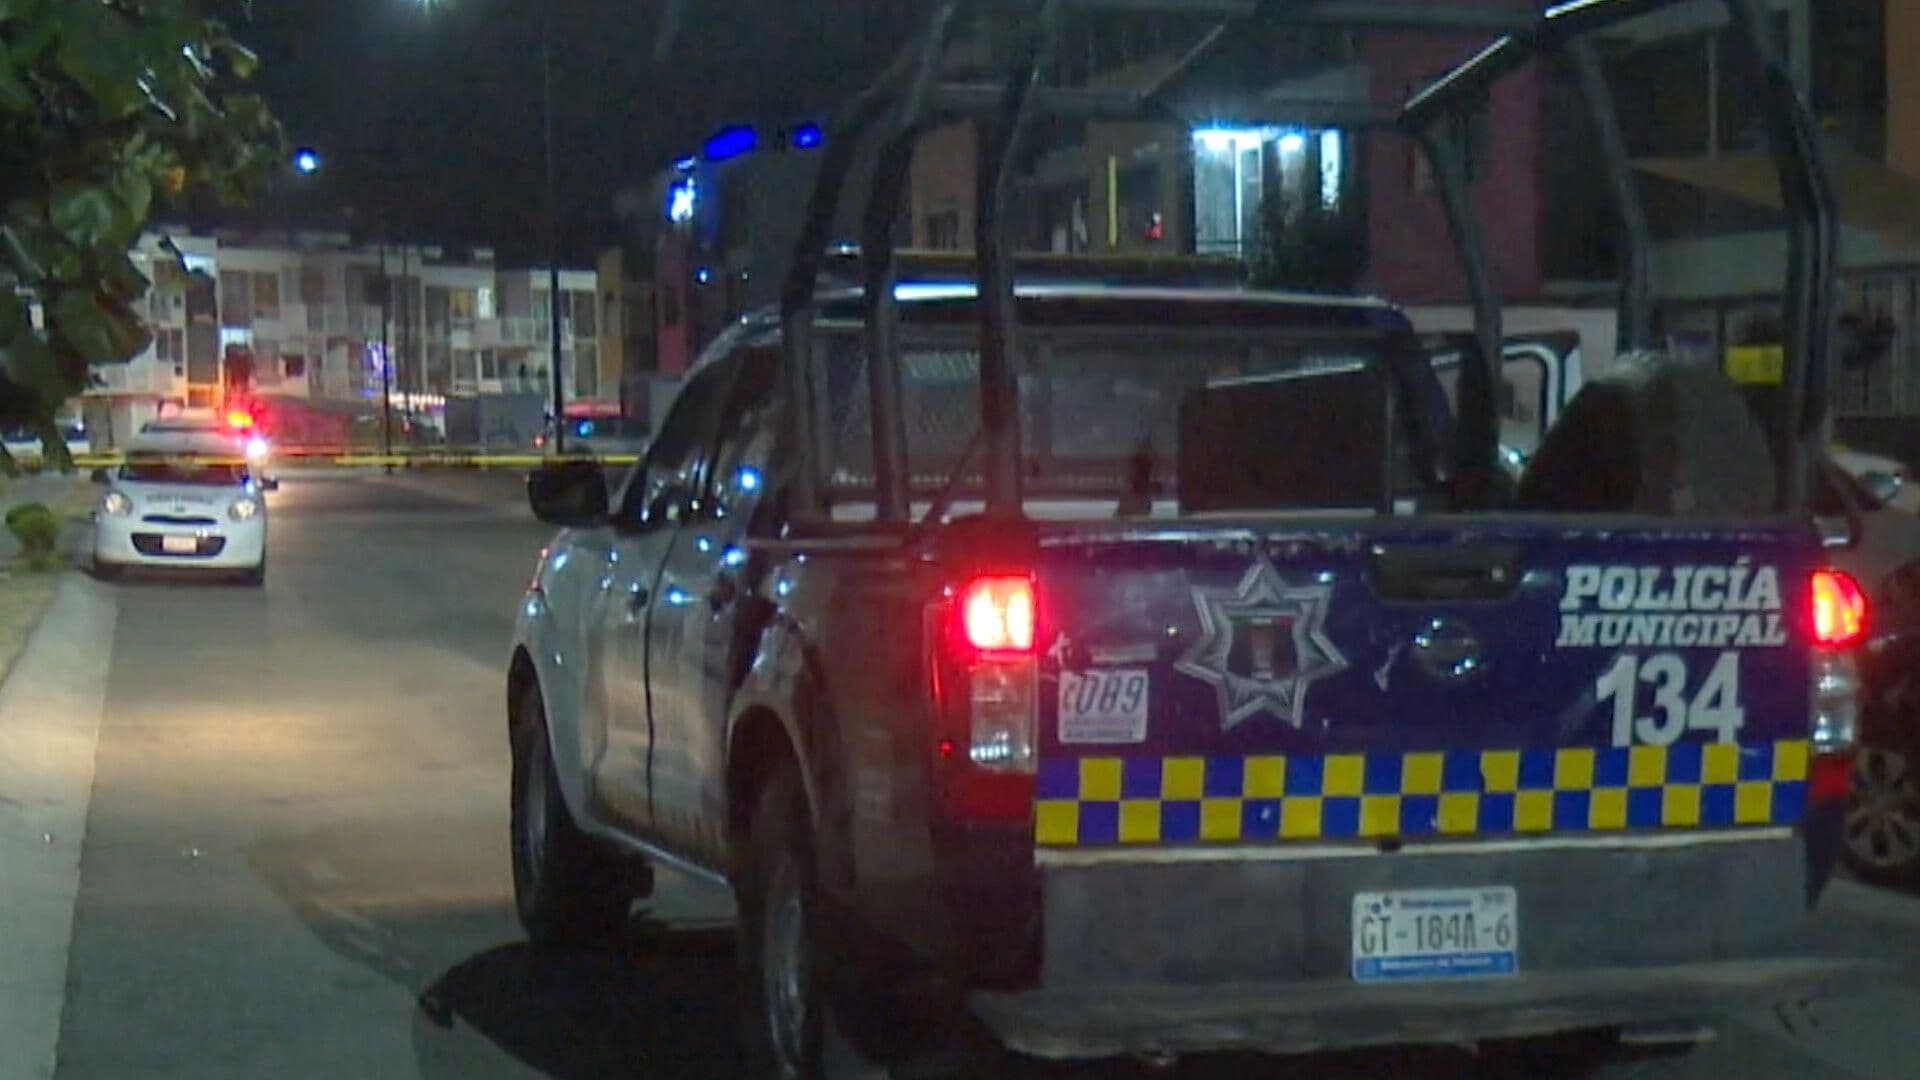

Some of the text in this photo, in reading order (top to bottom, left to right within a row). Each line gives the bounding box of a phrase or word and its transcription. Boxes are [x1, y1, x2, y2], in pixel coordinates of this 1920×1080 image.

[1559, 555, 1782, 611] POLICÍA
[1554, 614, 1787, 647] MUNICIPAL
[1596, 652, 1744, 747] 134
